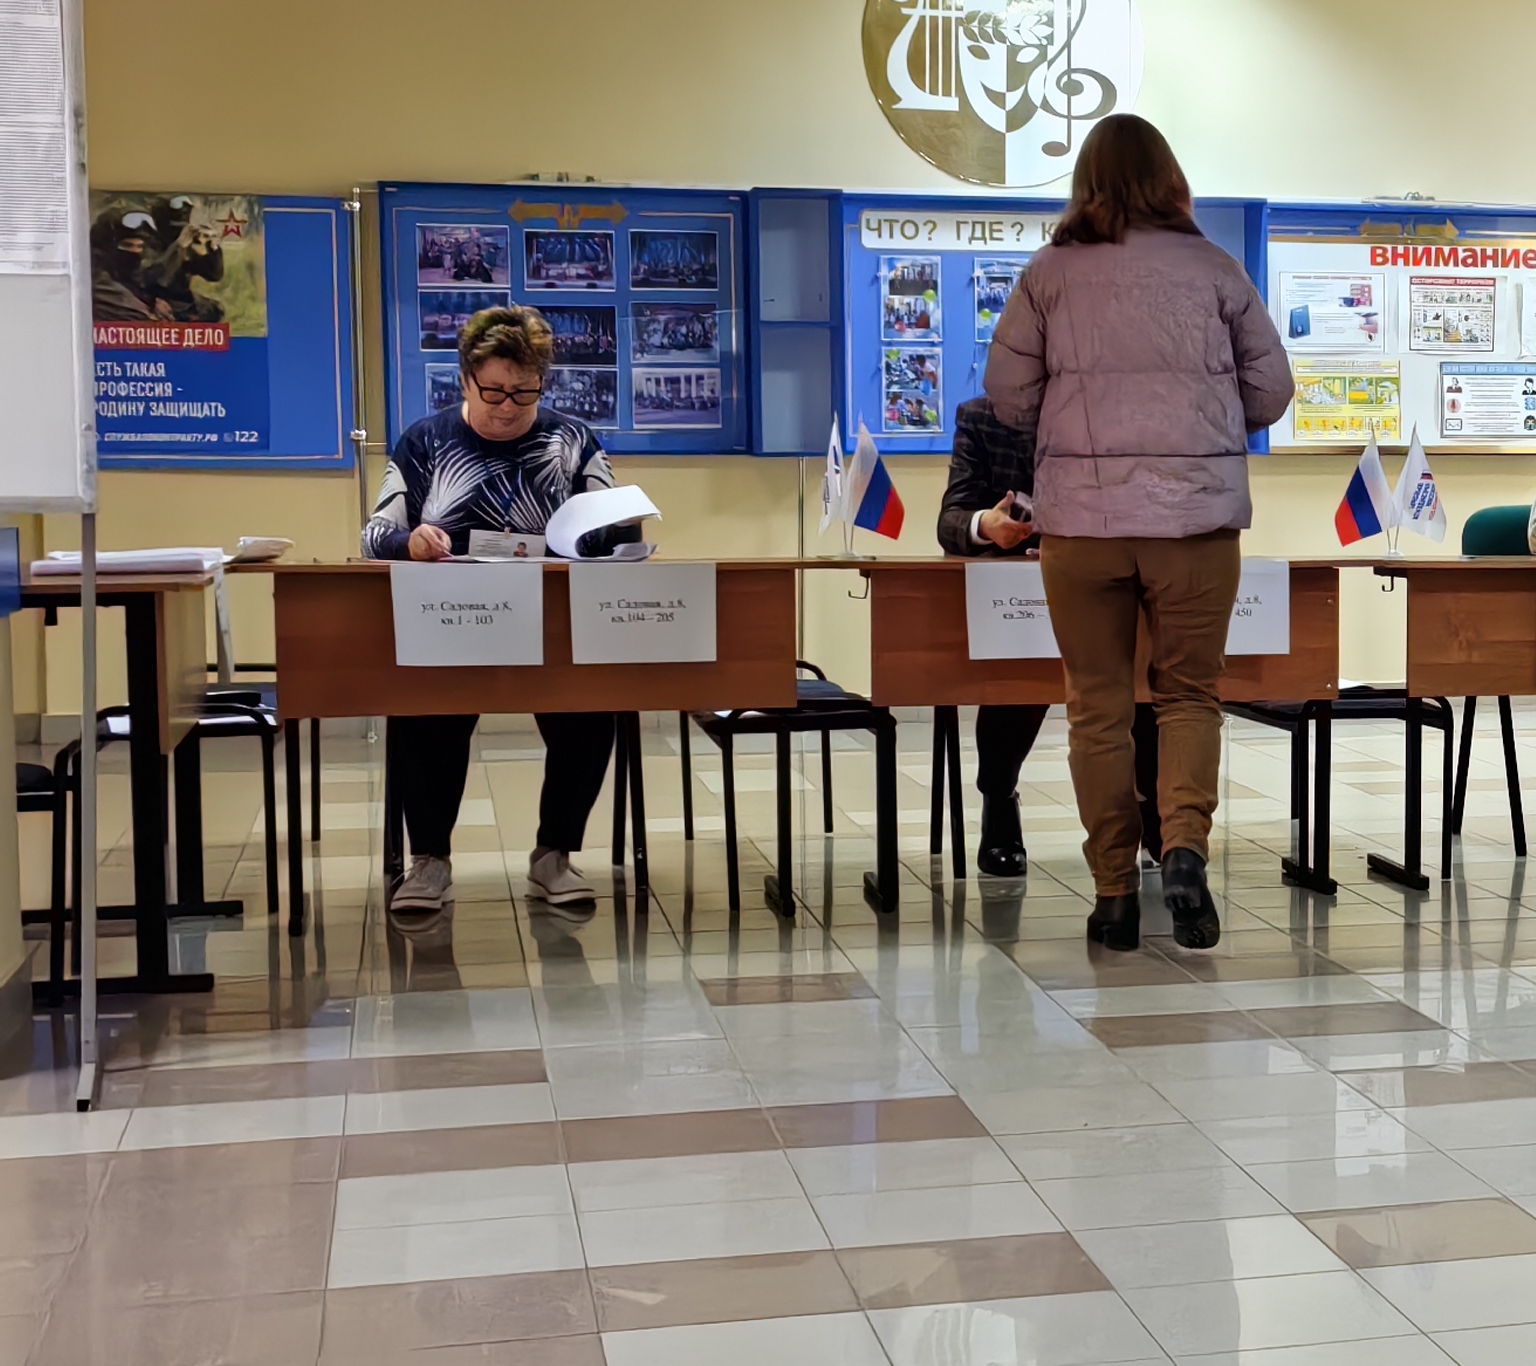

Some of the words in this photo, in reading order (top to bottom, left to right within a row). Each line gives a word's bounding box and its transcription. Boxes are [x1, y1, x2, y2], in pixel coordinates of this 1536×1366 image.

[865, 218, 938, 241] ЧТО?
[183, 328, 224, 348] ДЕЛО
[95, 361, 122, 377] СТЬ
[124, 362, 166, 377] ТАКАЯ
[149, 401, 226, 418] ЗАЩИЩАТЬ
[234, 431, 259, 443] 122
